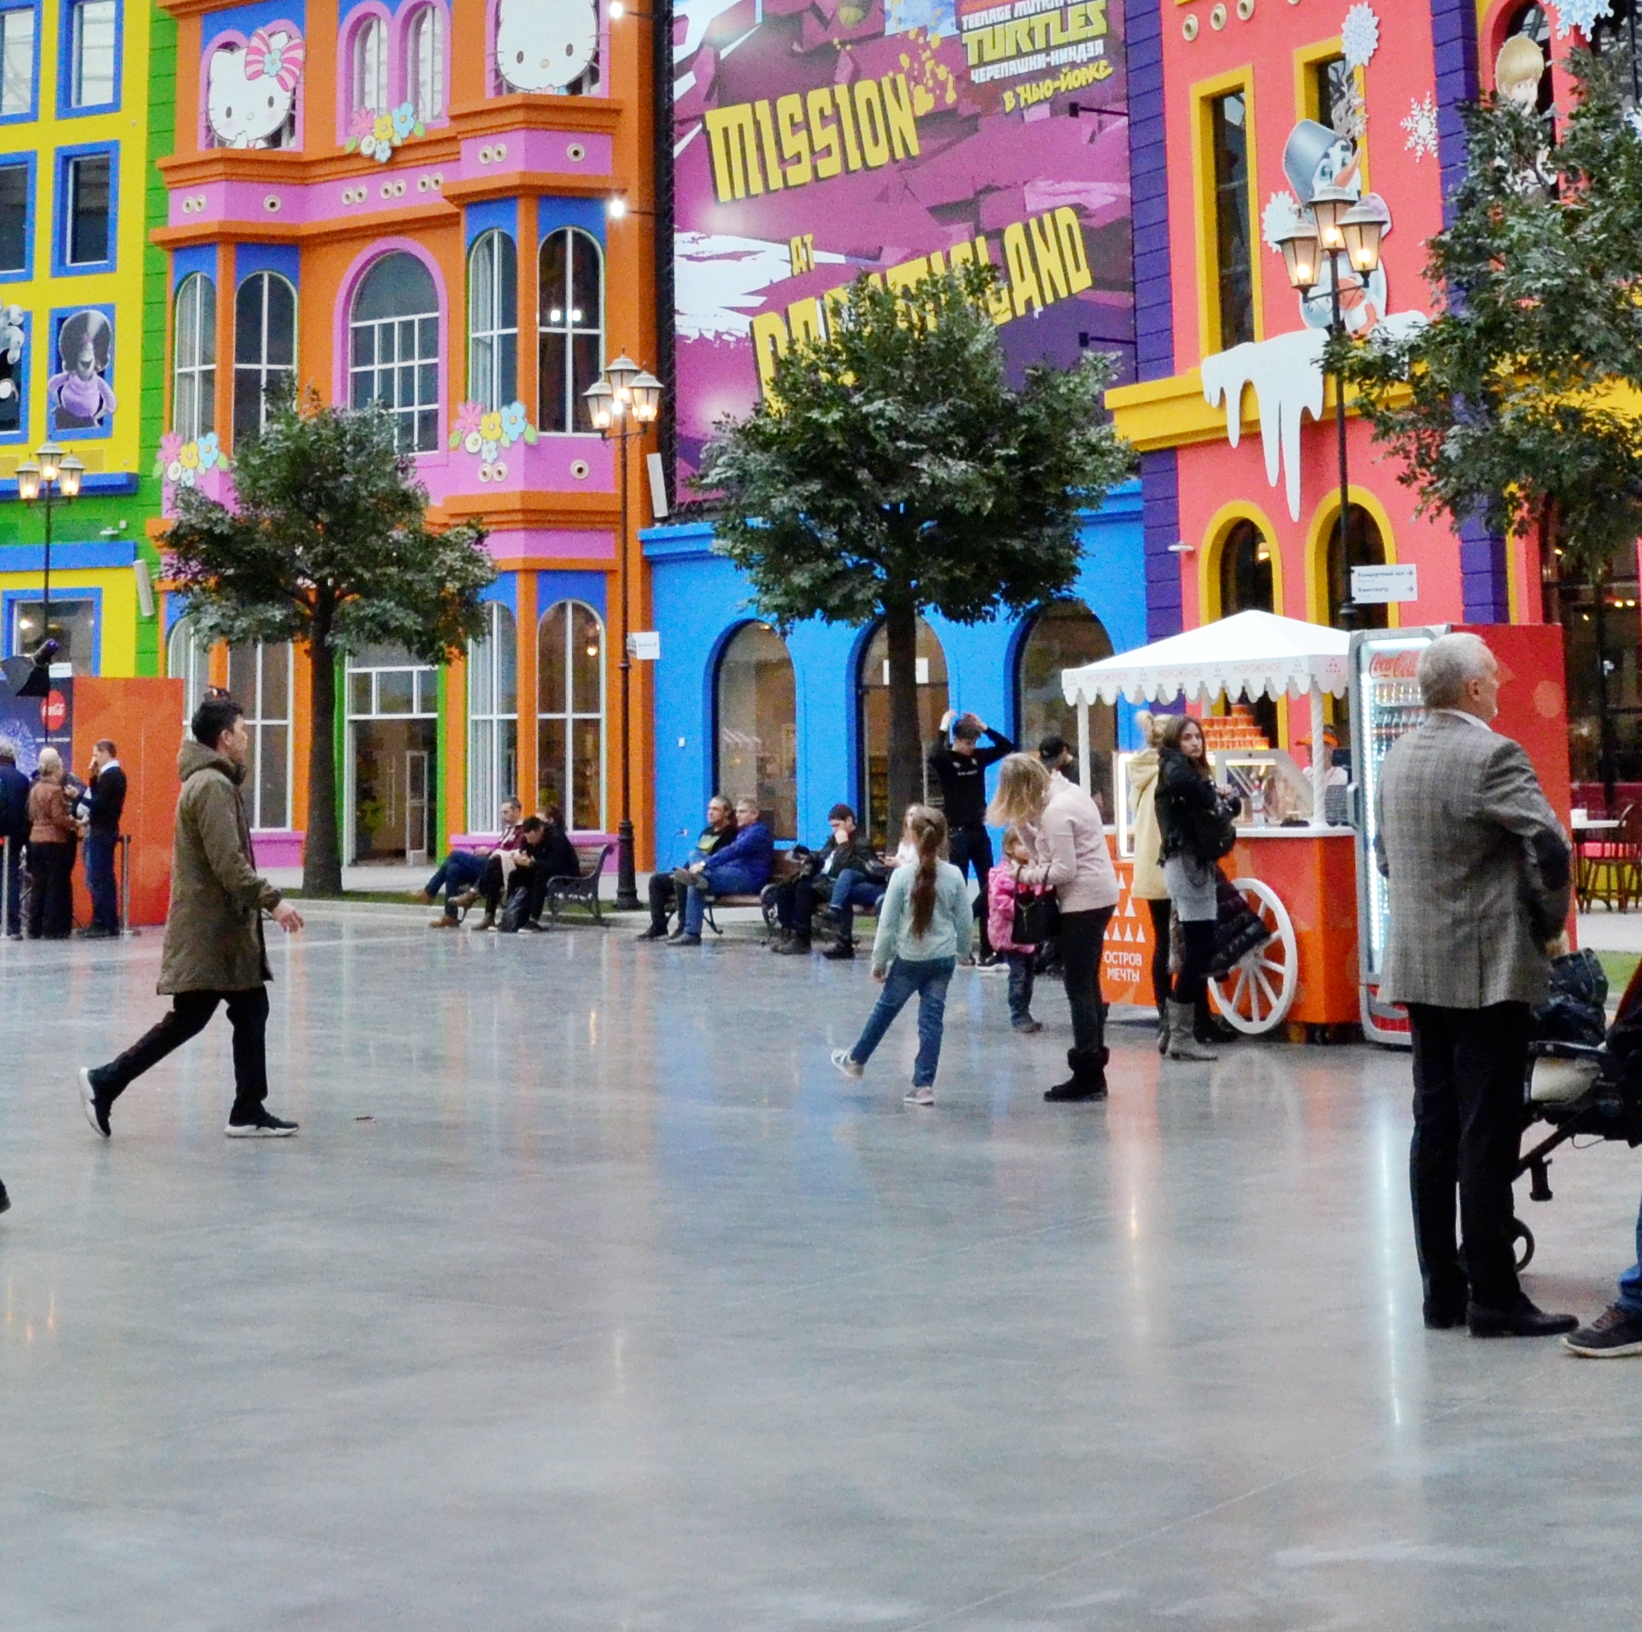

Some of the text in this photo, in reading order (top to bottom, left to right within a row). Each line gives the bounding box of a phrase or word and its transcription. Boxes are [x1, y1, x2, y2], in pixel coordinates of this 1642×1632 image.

[961, 5, 1011, 30] TEENAGE
[970, 39, 1104, 84] ЧЕРЕПАШКИ-НИНДЗЯ
[1002, 59, 1114, 113] В НЬЮ-ЙОРКЕ
[705, 73, 920, 203] MISSION
[790, 233, 815, 276] AT
[1233, 662, 1282, 675] МОРОЖЕНОЕ
[1104, 951, 1143, 967] ОСТРОВ
[1106, 967, 1141, 983] МЕЧТЫ
